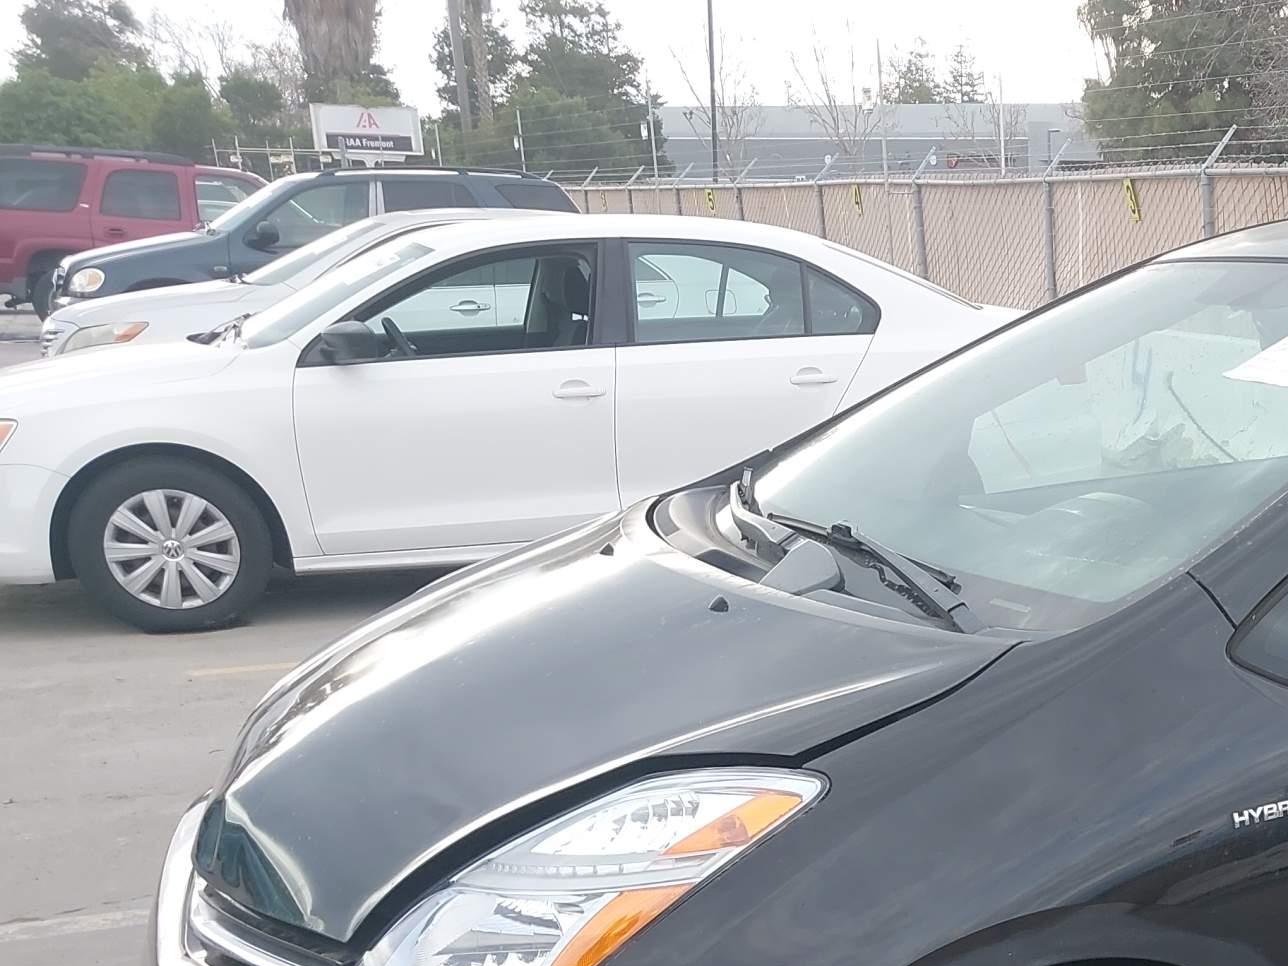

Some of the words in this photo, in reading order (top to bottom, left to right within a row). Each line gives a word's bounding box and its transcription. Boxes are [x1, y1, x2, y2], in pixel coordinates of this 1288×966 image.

[362, 138, 395, 149] Fremont
[706, 191, 716, 211] 5
[854, 185, 864, 215] 4
[1125, 184, 1137, 215] 3
